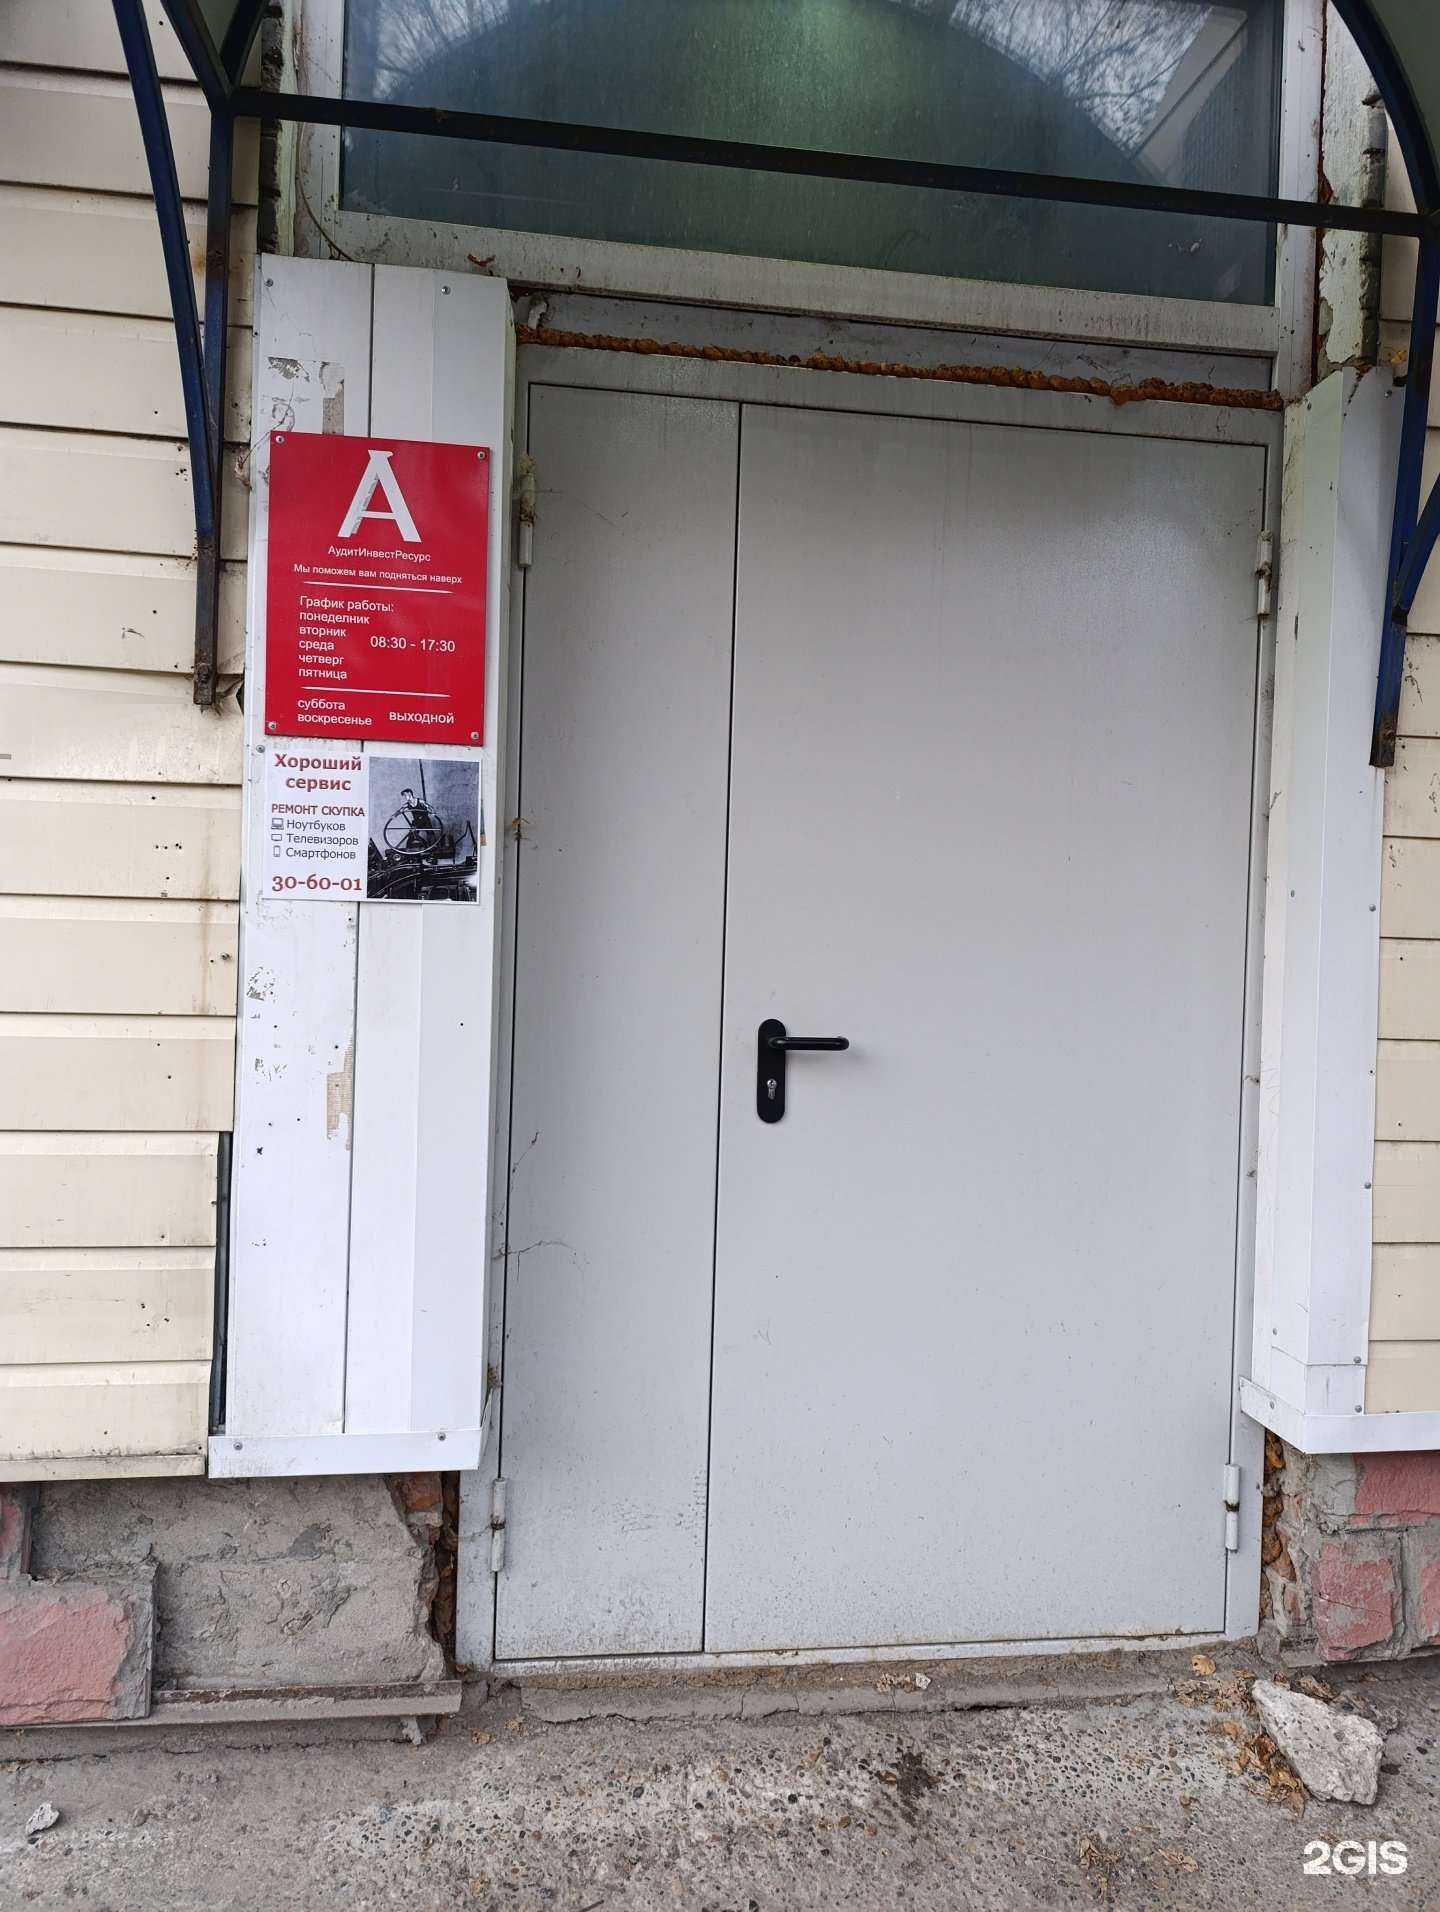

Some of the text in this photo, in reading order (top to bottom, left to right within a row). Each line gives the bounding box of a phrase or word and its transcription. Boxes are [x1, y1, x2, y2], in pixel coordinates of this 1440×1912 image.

[337, 449, 422, 543] А
[328, 545, 431, 563] АудитИнвестРесурс
[294, 564, 462, 585] Мы поможем вам подняться наверх
[299, 596, 394, 613] График работы:
[299, 612, 370, 625] понеделник
[299, 626, 346, 638] вторник
[299, 640, 335, 652] среда
[370, 636, 407, 649] 08:30
[420, 638, 456, 652] 17:30
[298, 653, 345, 666] четверг
[298, 667, 347, 680] пятница
[297, 698, 346, 711] суббота
[297, 714, 372, 726] воскресенье
[389, 711, 454, 724] выходной
[274, 753, 362, 771] Хороший
[286, 777, 352, 793] сервис
[271, 803, 366, 817] РЕМОНТ СКУПКА
[286, 819, 346, 832] Ноутбуков
[287, 833, 359, 846] Телевизоров
[285, 847, 357, 860] Смартфонов
[271, 873, 363, 892] 30-60-01
